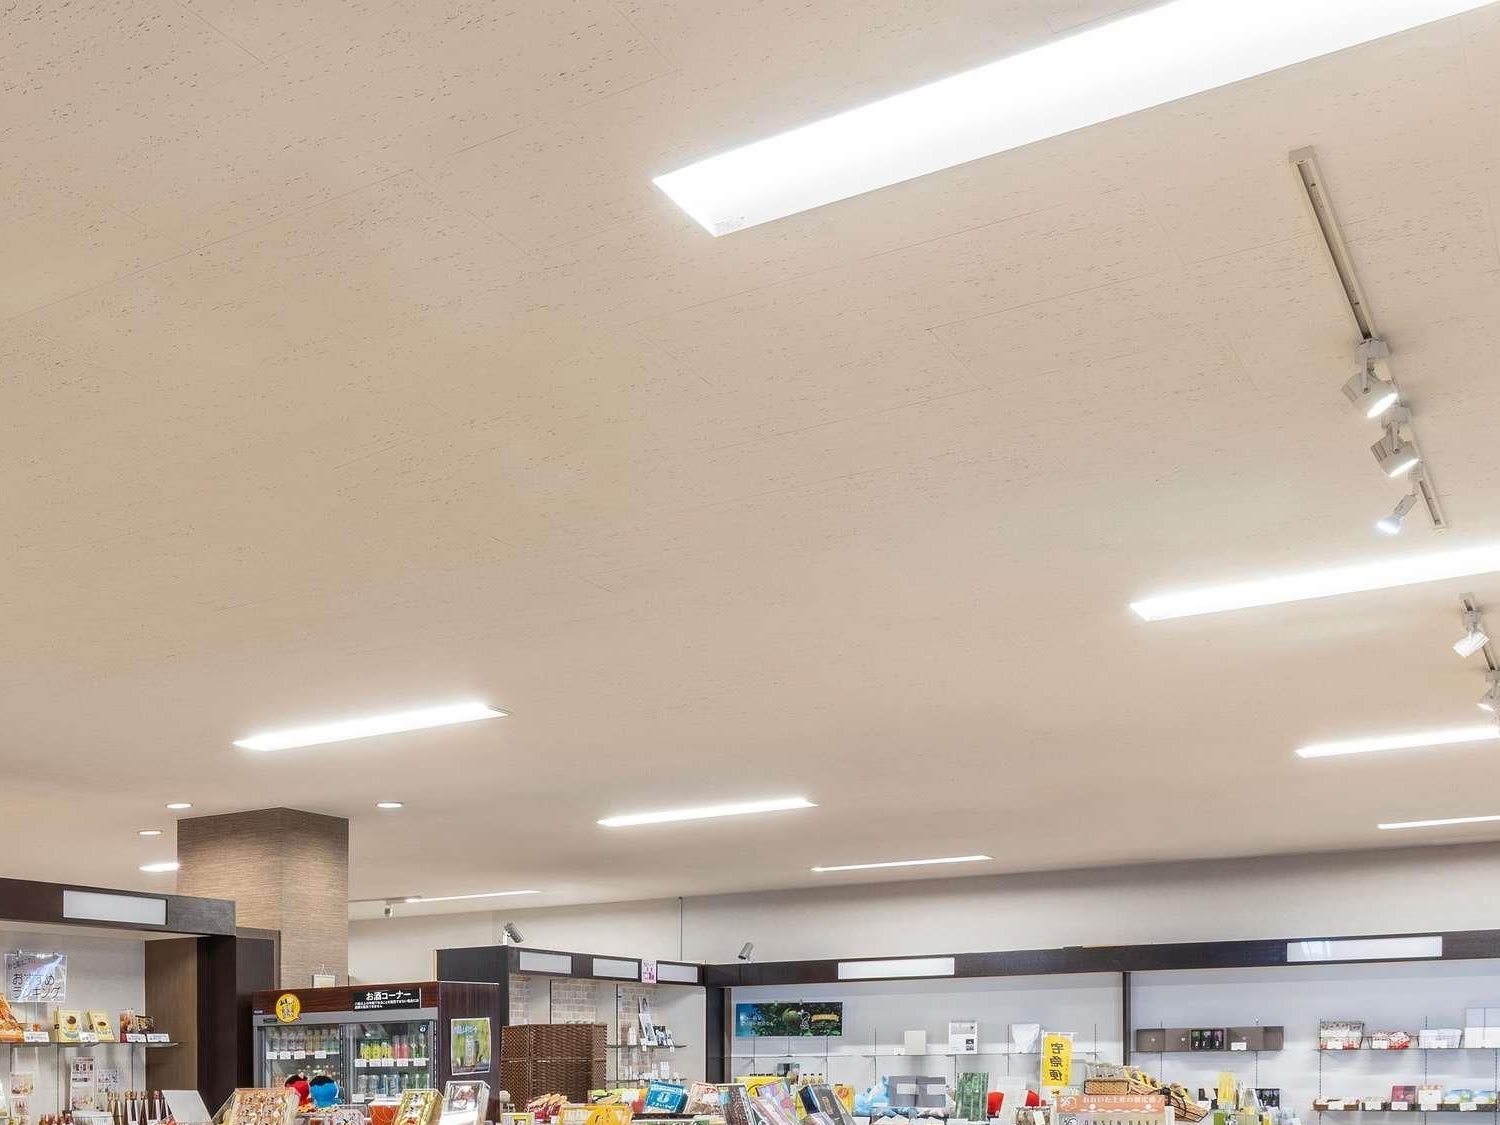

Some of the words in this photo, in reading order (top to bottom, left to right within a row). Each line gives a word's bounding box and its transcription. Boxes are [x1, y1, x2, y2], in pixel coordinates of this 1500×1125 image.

[366, 991, 411, 1001] お酒コーナー
